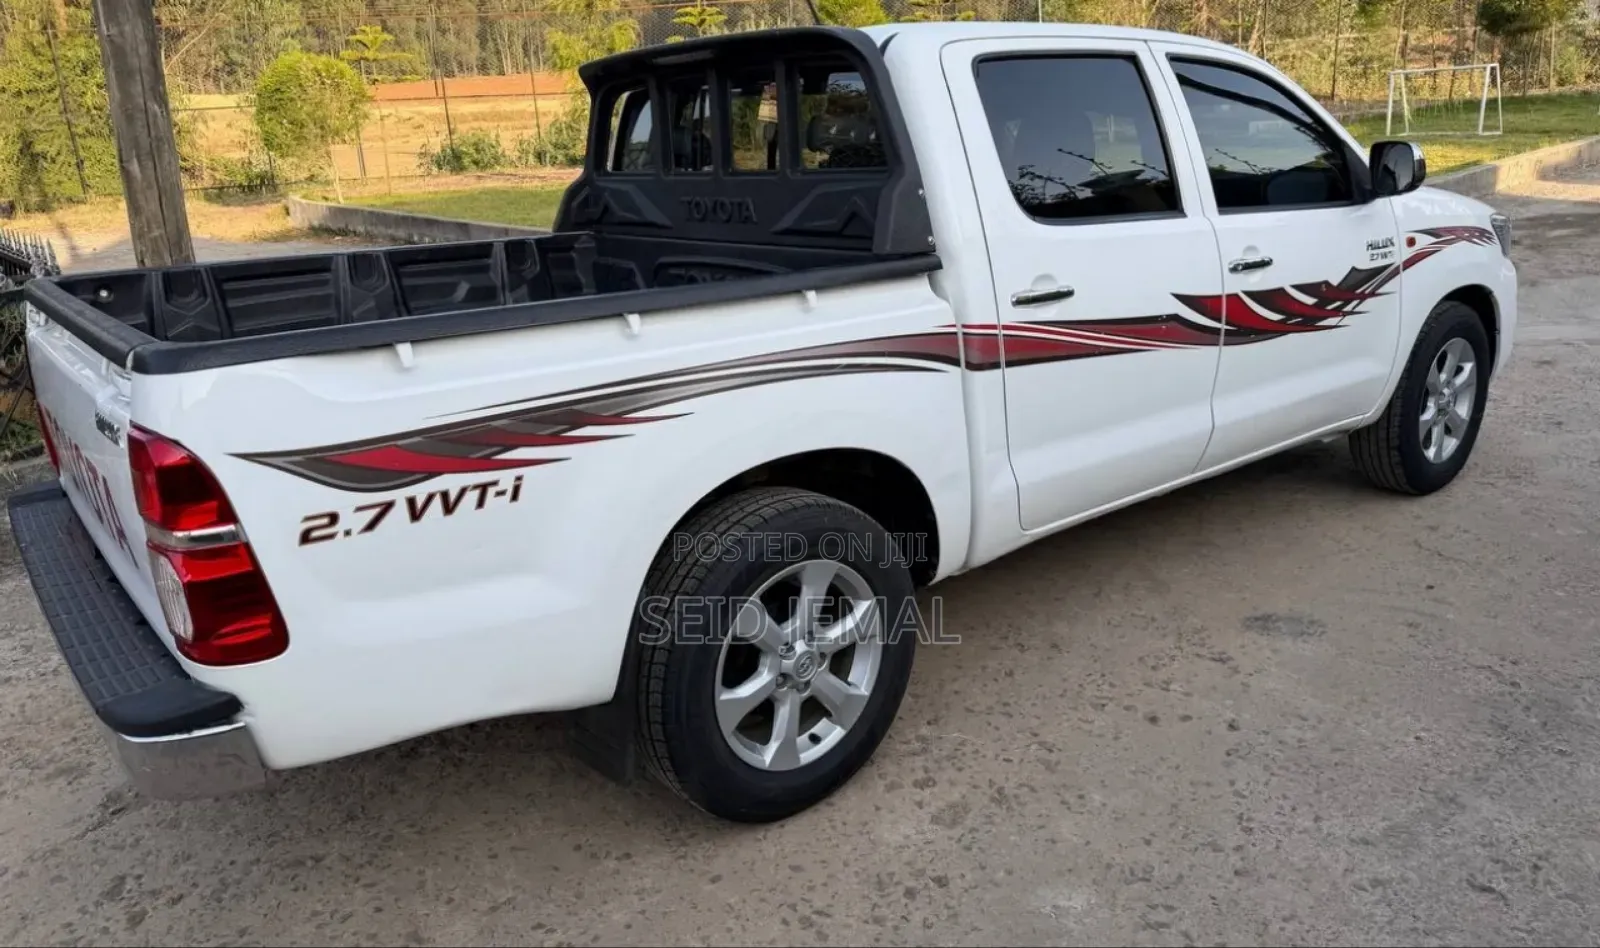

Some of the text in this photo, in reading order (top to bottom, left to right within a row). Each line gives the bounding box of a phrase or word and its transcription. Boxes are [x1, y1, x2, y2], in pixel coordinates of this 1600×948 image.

[680, 195, 758, 225] TOYOTA
[298, 474, 524, 547] 2.7 VVT-i
